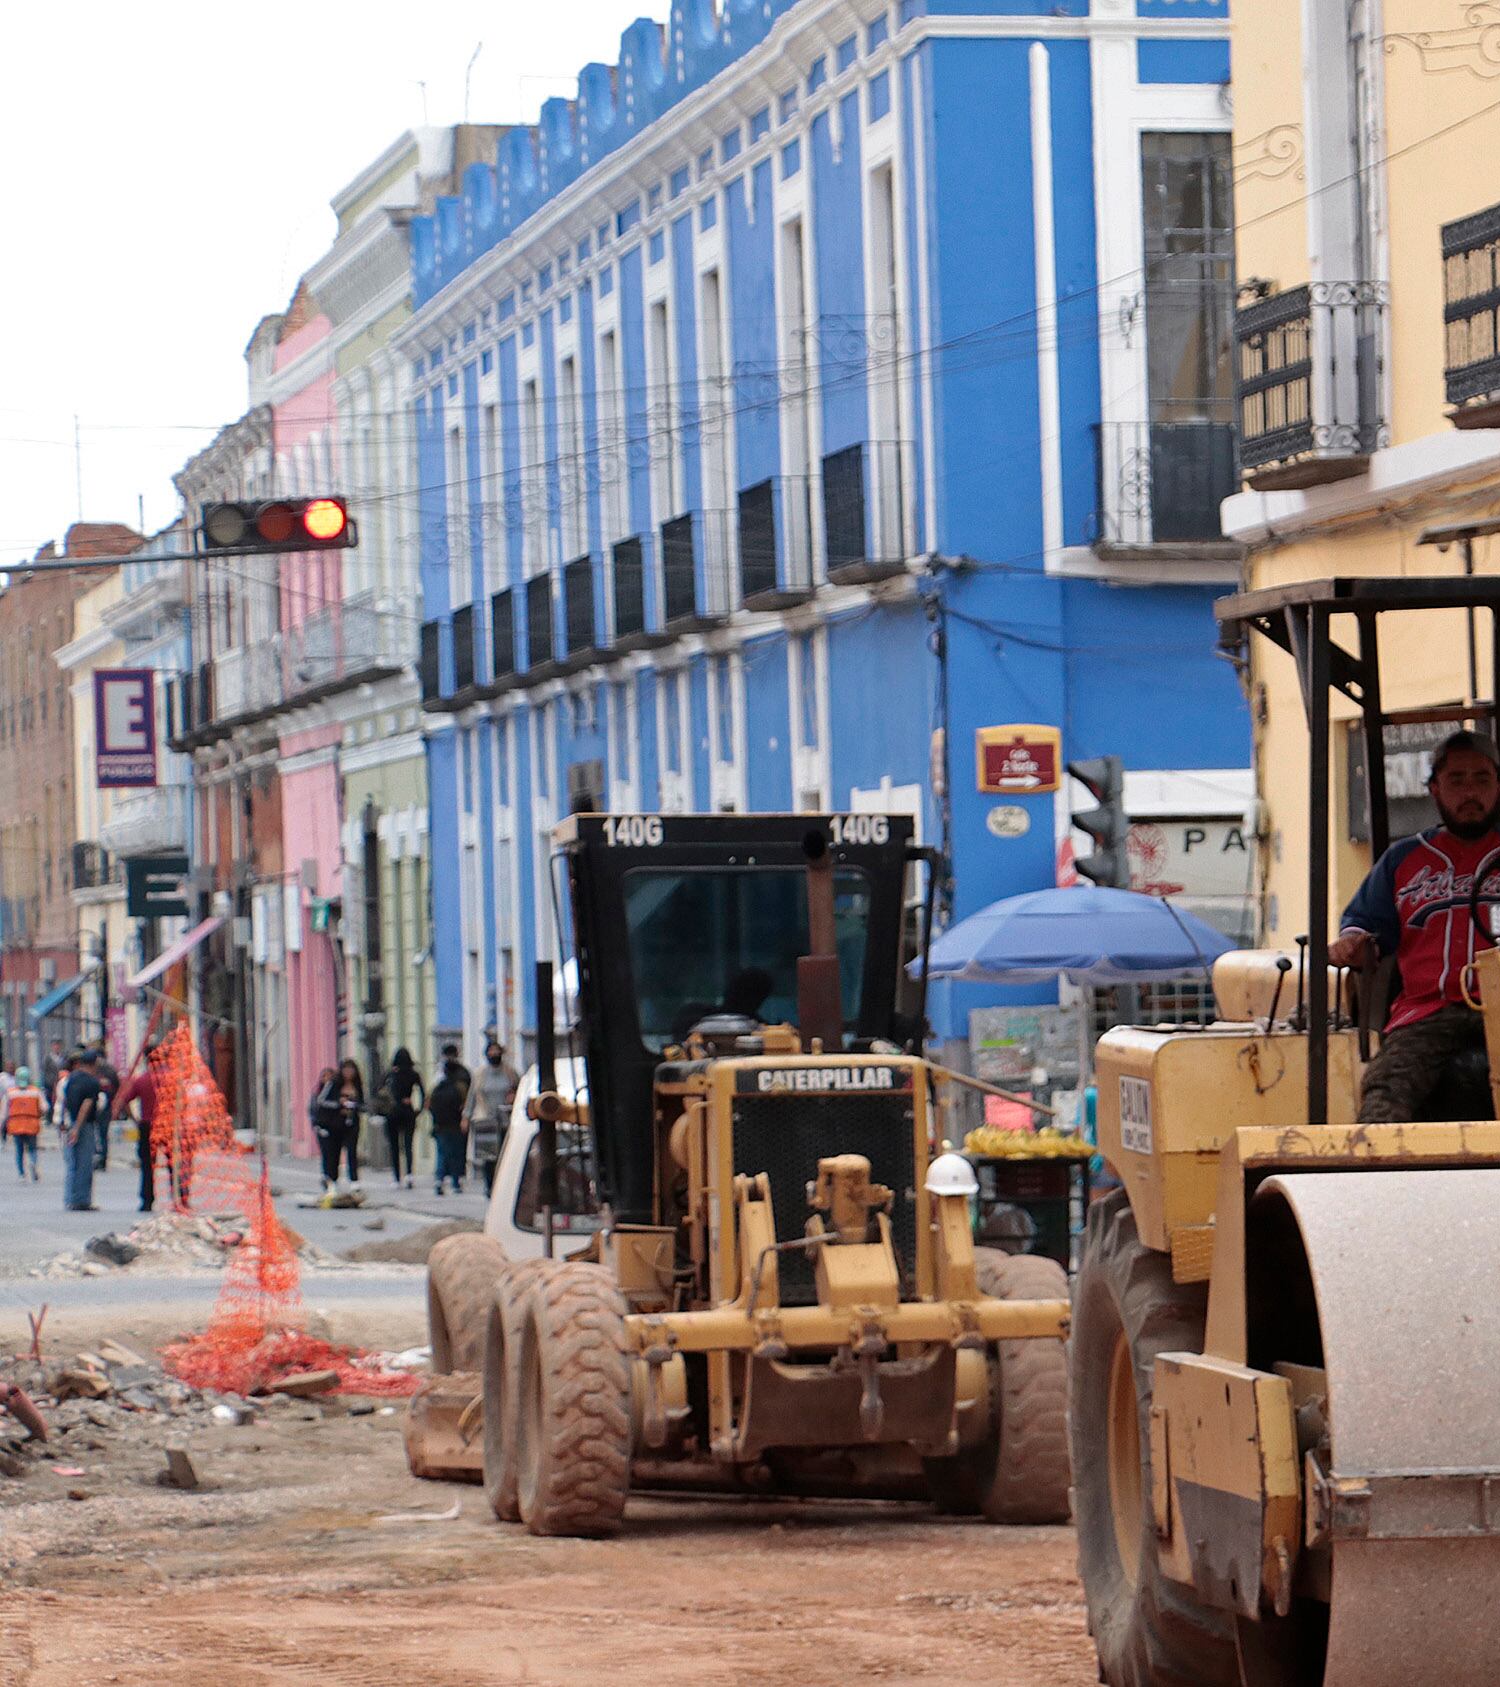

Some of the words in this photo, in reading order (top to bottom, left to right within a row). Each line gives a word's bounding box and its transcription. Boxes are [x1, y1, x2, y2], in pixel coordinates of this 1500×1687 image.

[103, 680, 147, 750] E
[602, 815, 664, 847] 140G
[829, 815, 889, 846] 140G
[758, 1067, 893, 1091] CATERPILLAR
